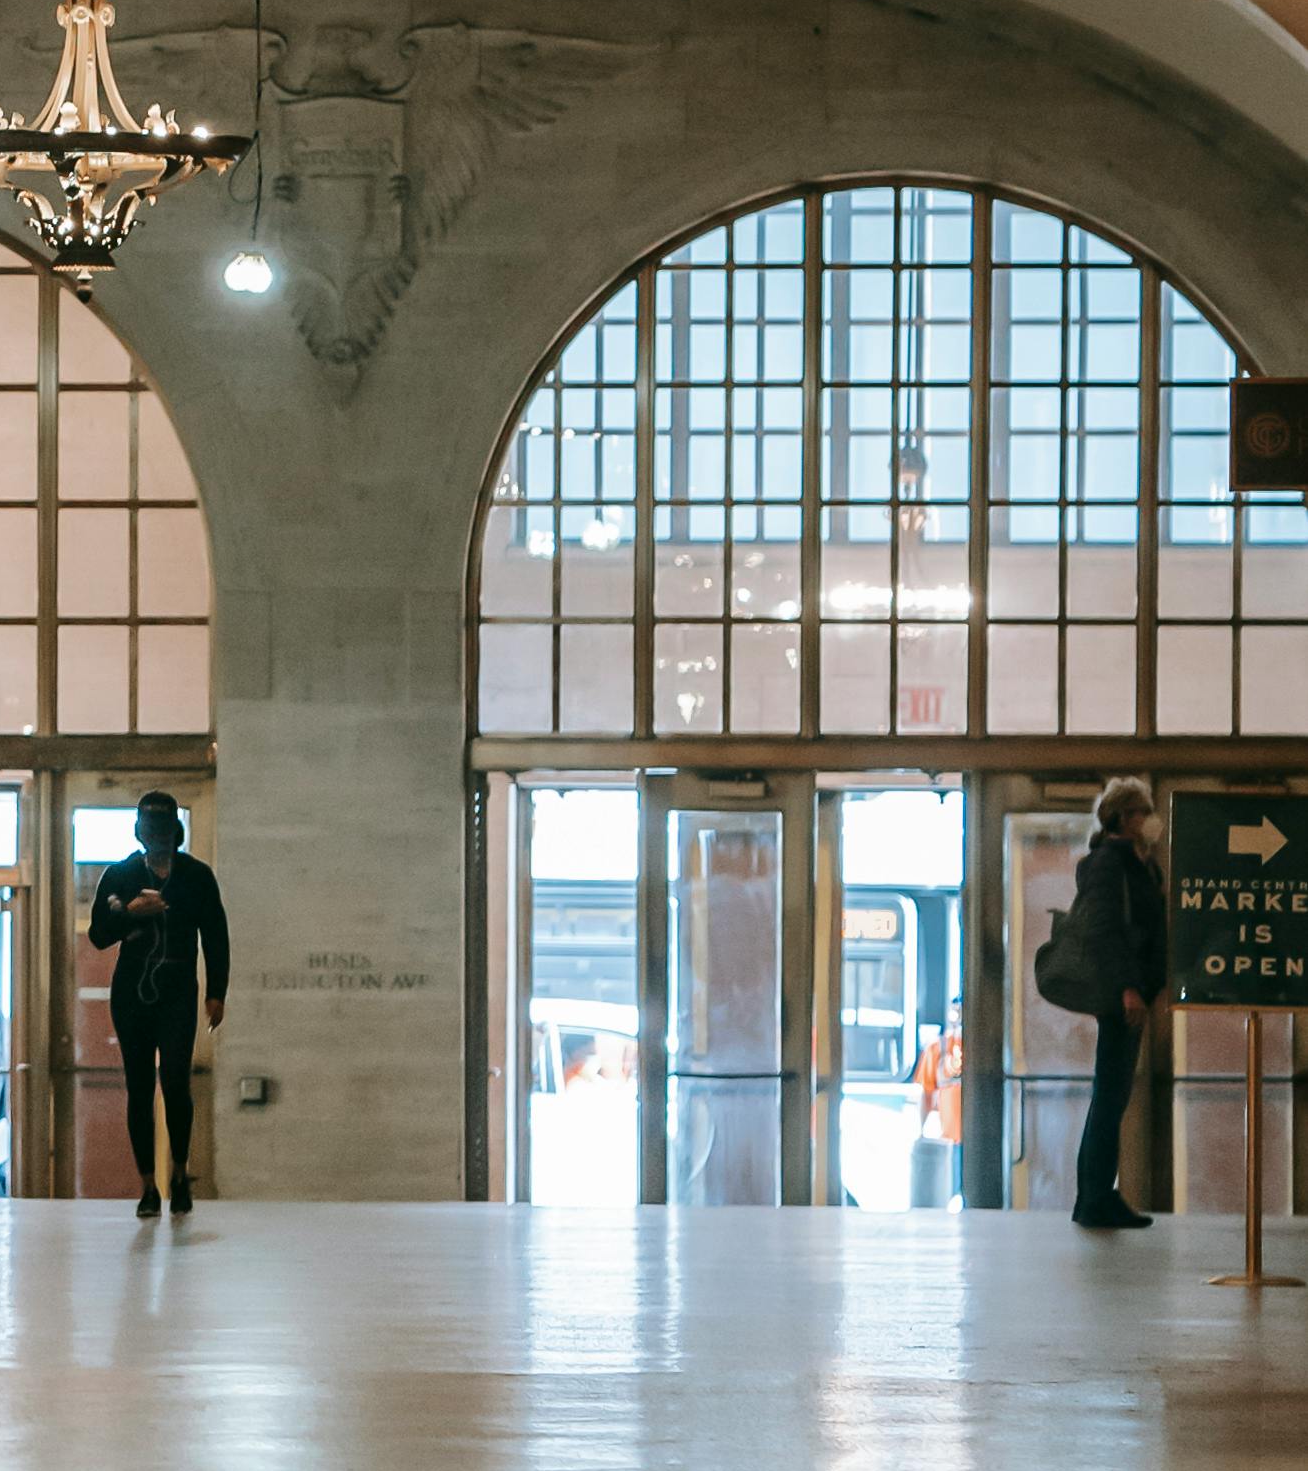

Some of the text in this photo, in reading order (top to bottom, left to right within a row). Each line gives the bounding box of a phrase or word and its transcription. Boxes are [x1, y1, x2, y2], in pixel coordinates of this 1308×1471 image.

[1181, 878, 1241, 888] GRAND
[1181, 891, 1308, 912] MARKE
[1239, 924, 1272, 943] IS
[1205, 955, 1304, 976] OPEN
